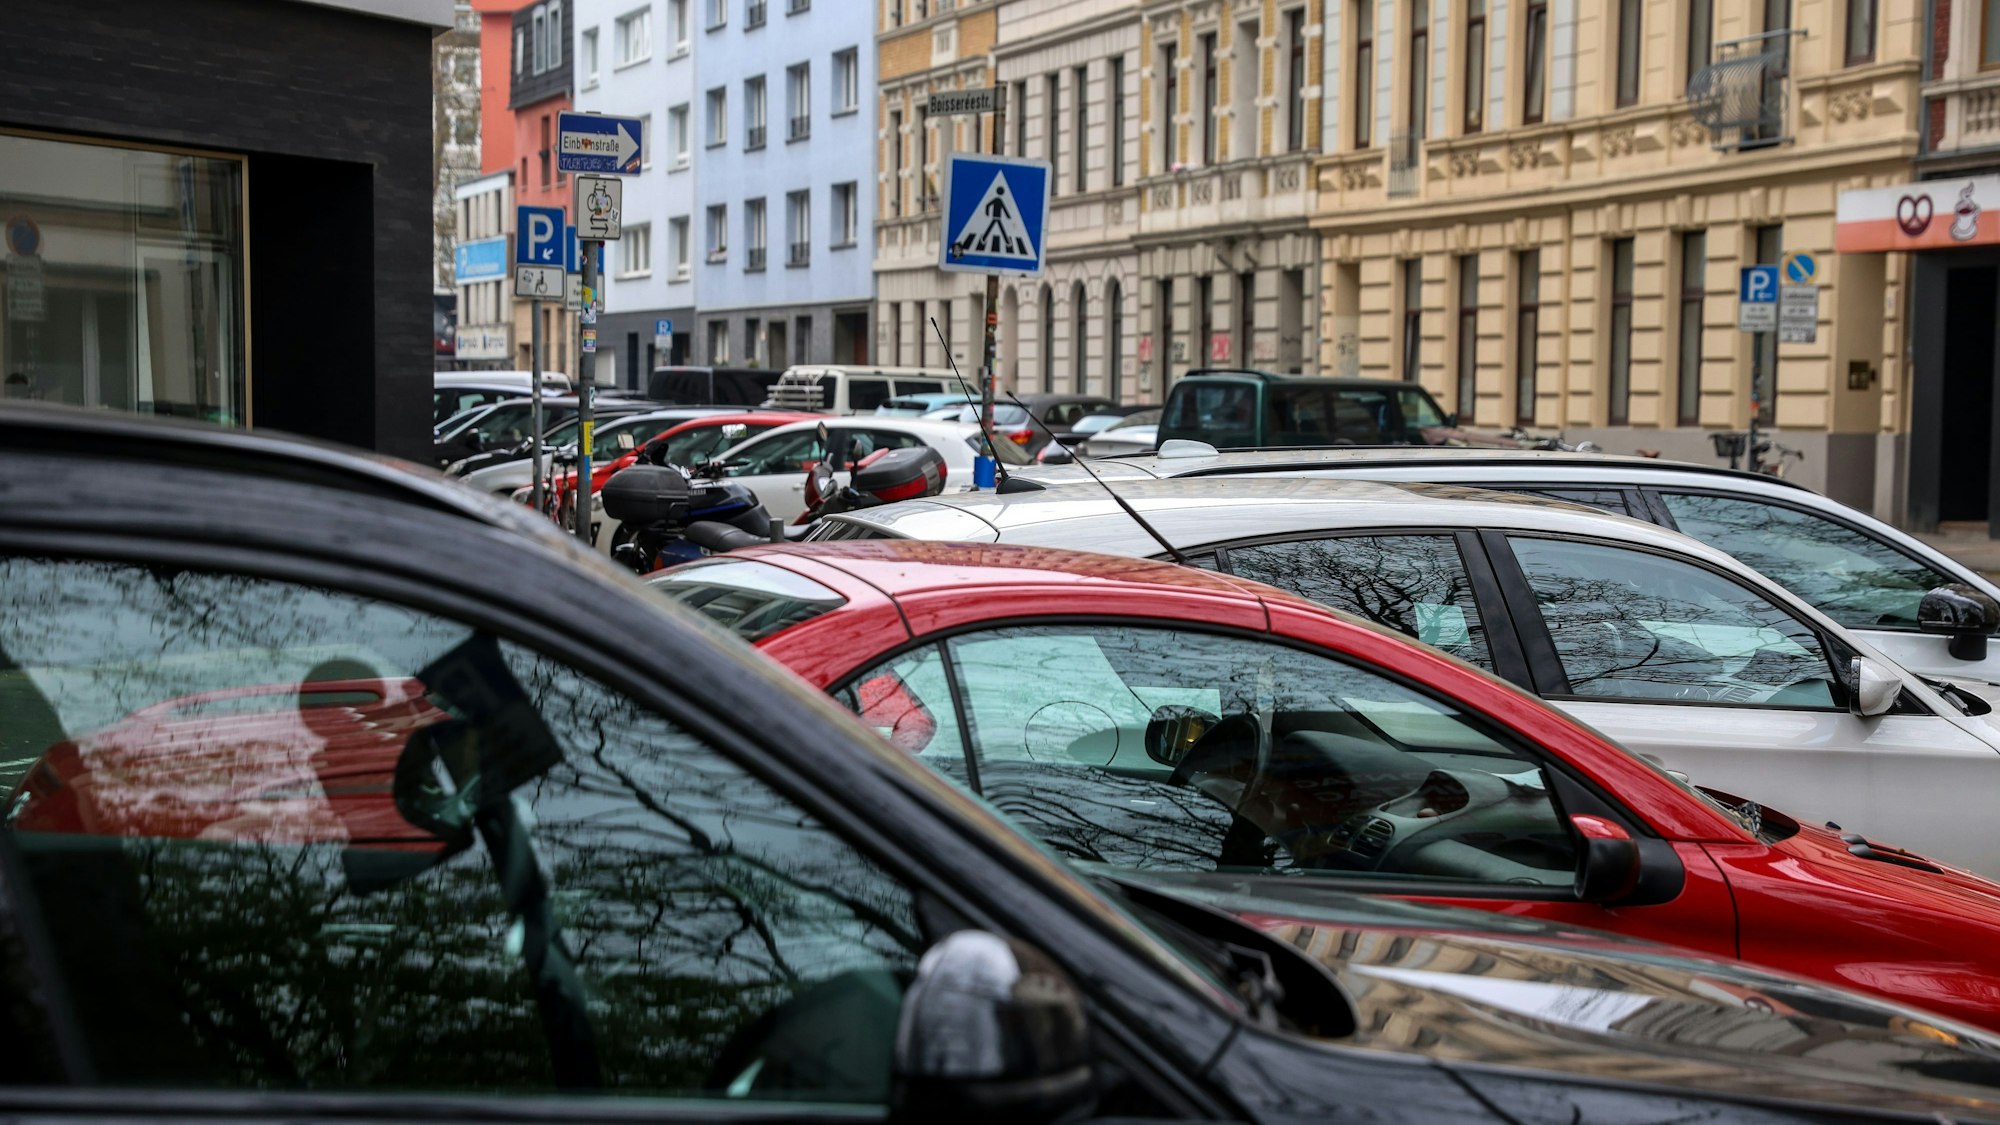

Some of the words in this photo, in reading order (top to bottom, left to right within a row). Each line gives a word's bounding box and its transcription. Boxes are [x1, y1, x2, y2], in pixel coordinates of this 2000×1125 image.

[931, 93, 991, 113] Boisseréestr.
[563, 136, 620, 152] Einbnstraße
[528, 213, 554, 260] P
[1749, 270, 1770, 300] P
